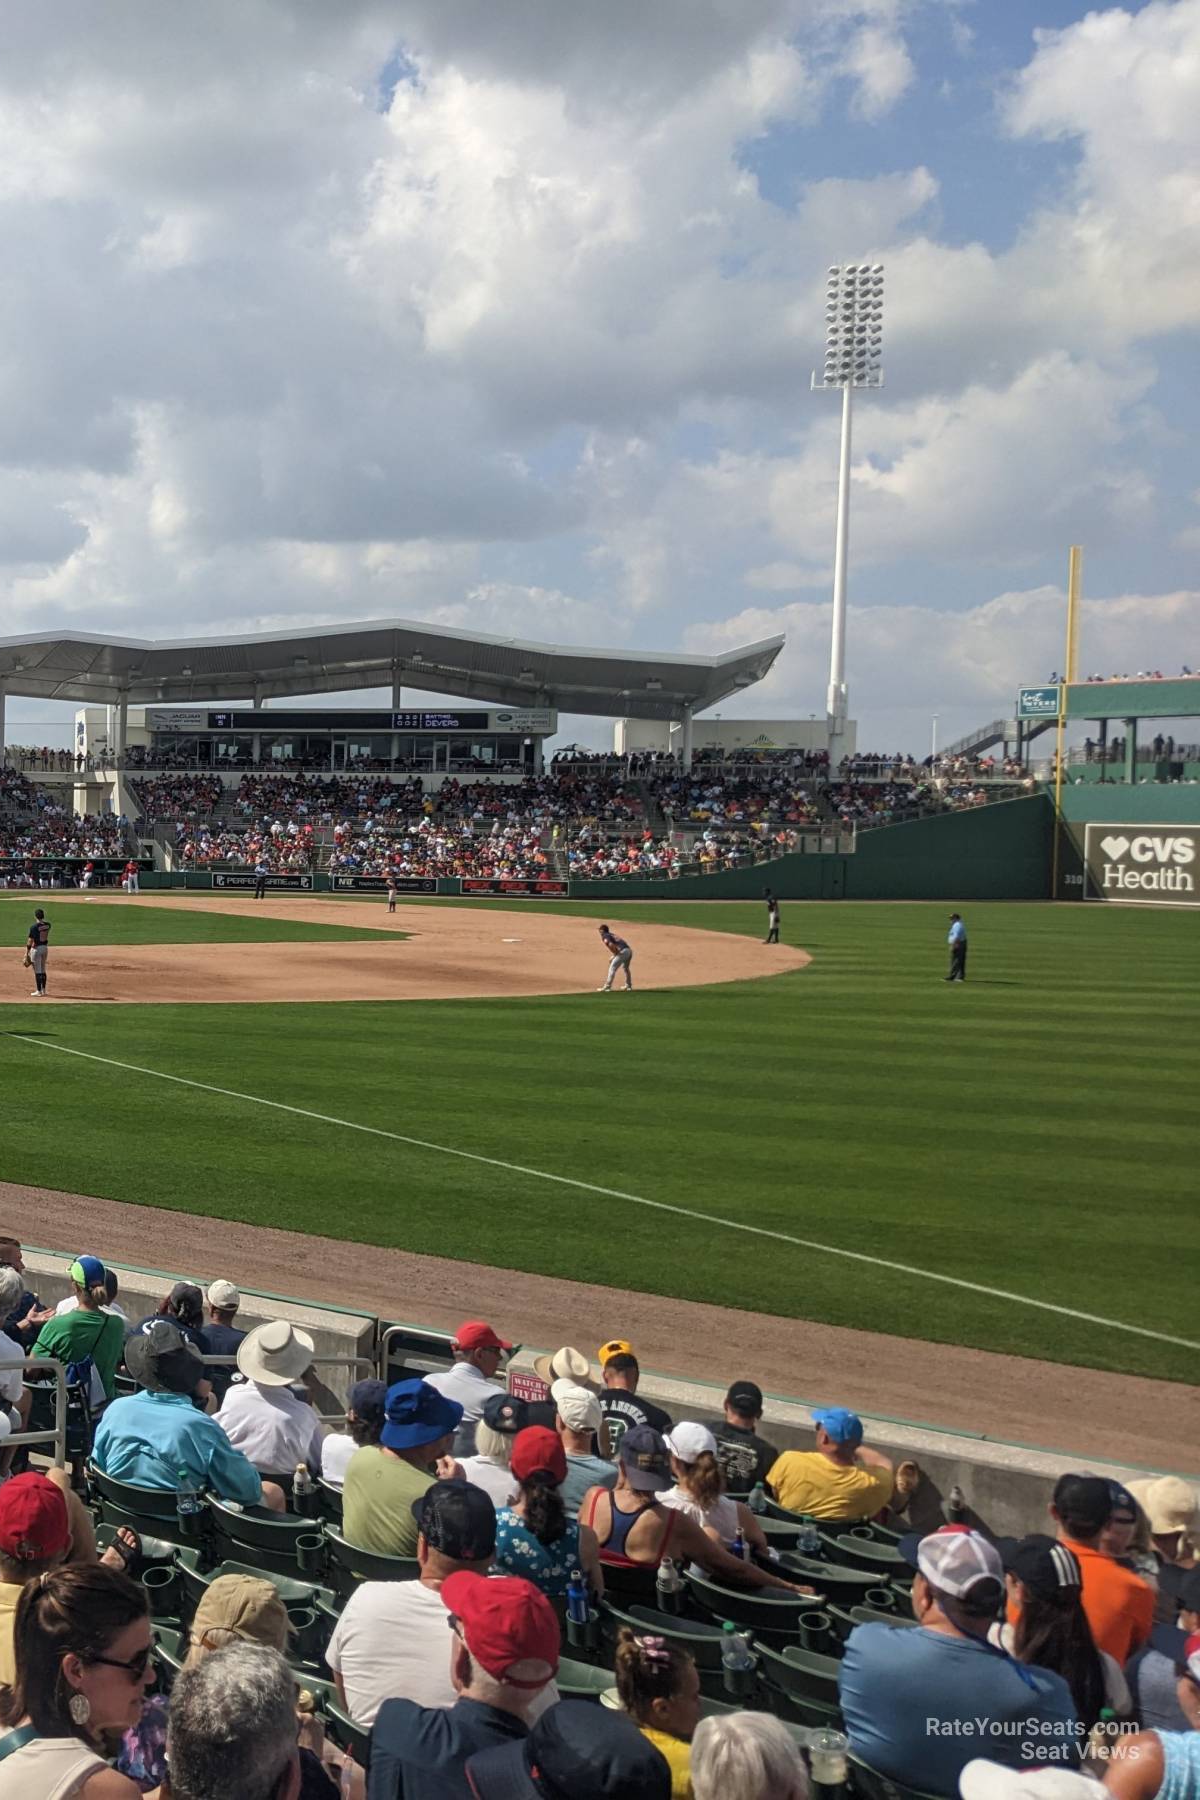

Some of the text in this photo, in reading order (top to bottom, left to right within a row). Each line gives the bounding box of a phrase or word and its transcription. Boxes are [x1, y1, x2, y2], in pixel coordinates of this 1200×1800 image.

[1130, 836, 1196, 863] CVS
[1064, 874, 1083, 885] 310
[1102, 864, 1194, 891] Health
[514, 1377, 541, 1389] WATCH
[513, 1389, 531, 1401] FLY
